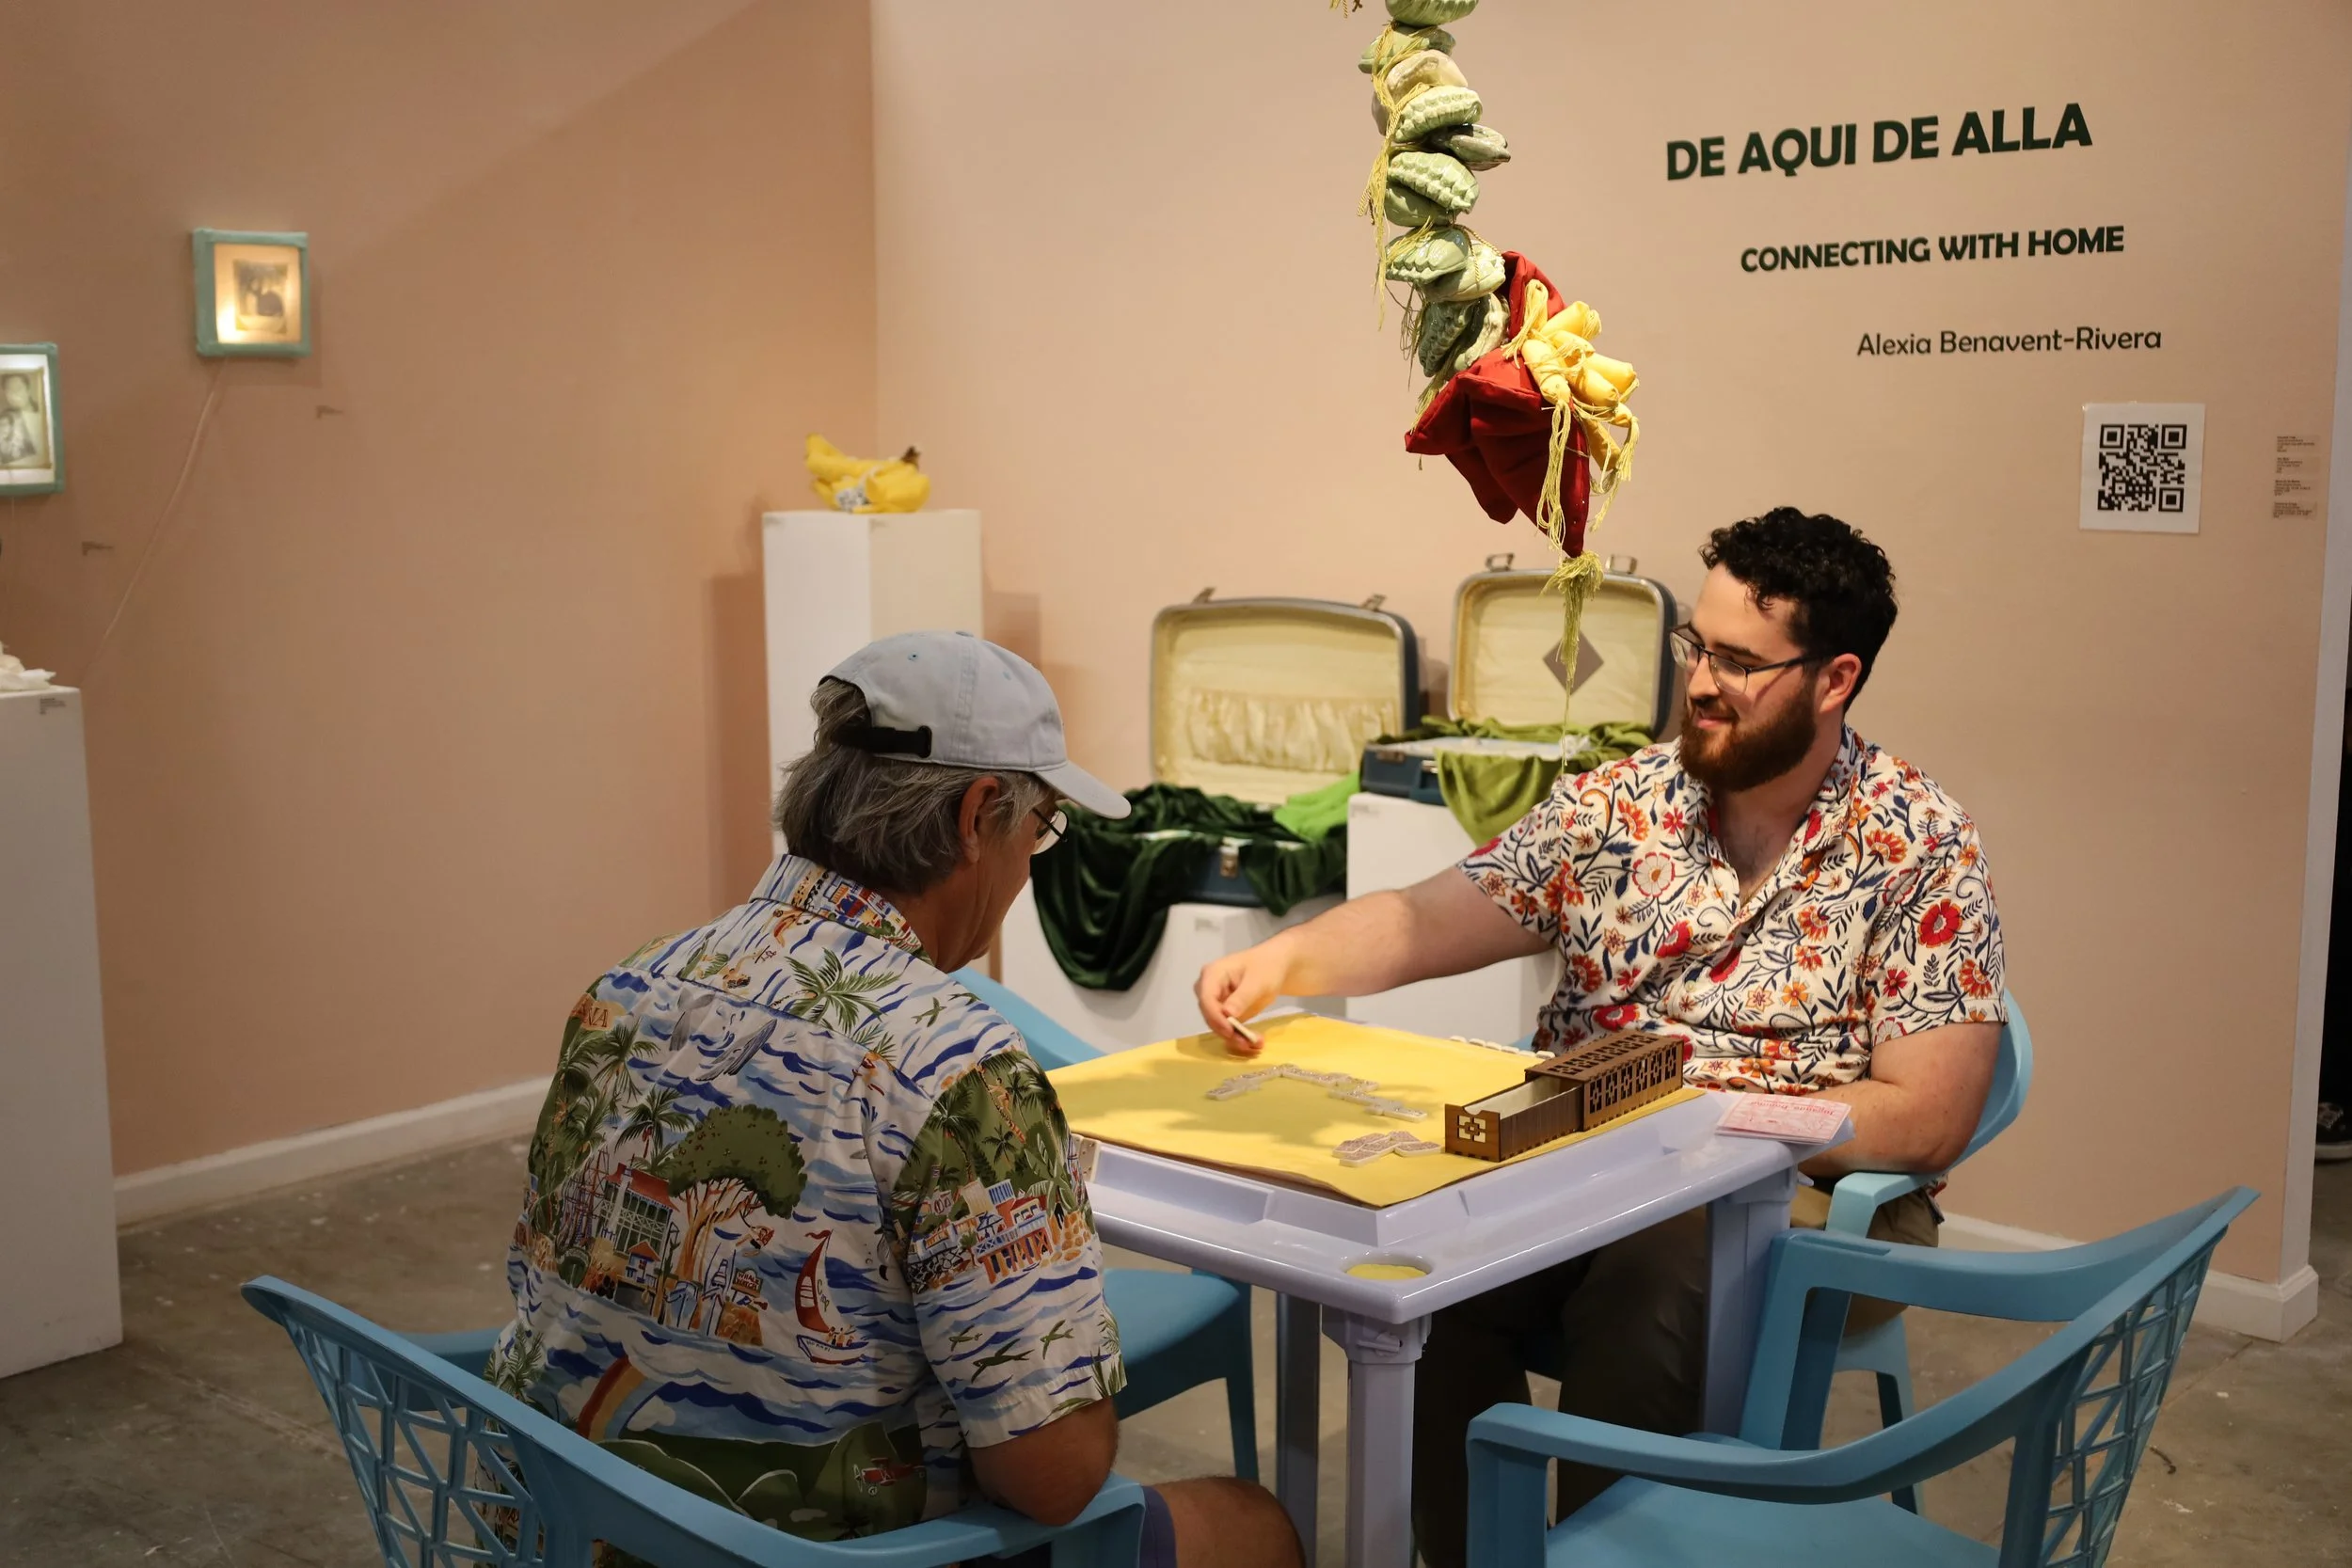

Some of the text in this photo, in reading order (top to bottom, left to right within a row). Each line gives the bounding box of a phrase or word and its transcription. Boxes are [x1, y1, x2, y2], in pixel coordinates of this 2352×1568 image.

[1666, 102, 2093, 182] DE AQUI DE ALLA
[1740, 225, 2125, 273] CONNECTING WITH HOME
[1856, 325, 2162, 356] Alexia Benavent-Rivera
